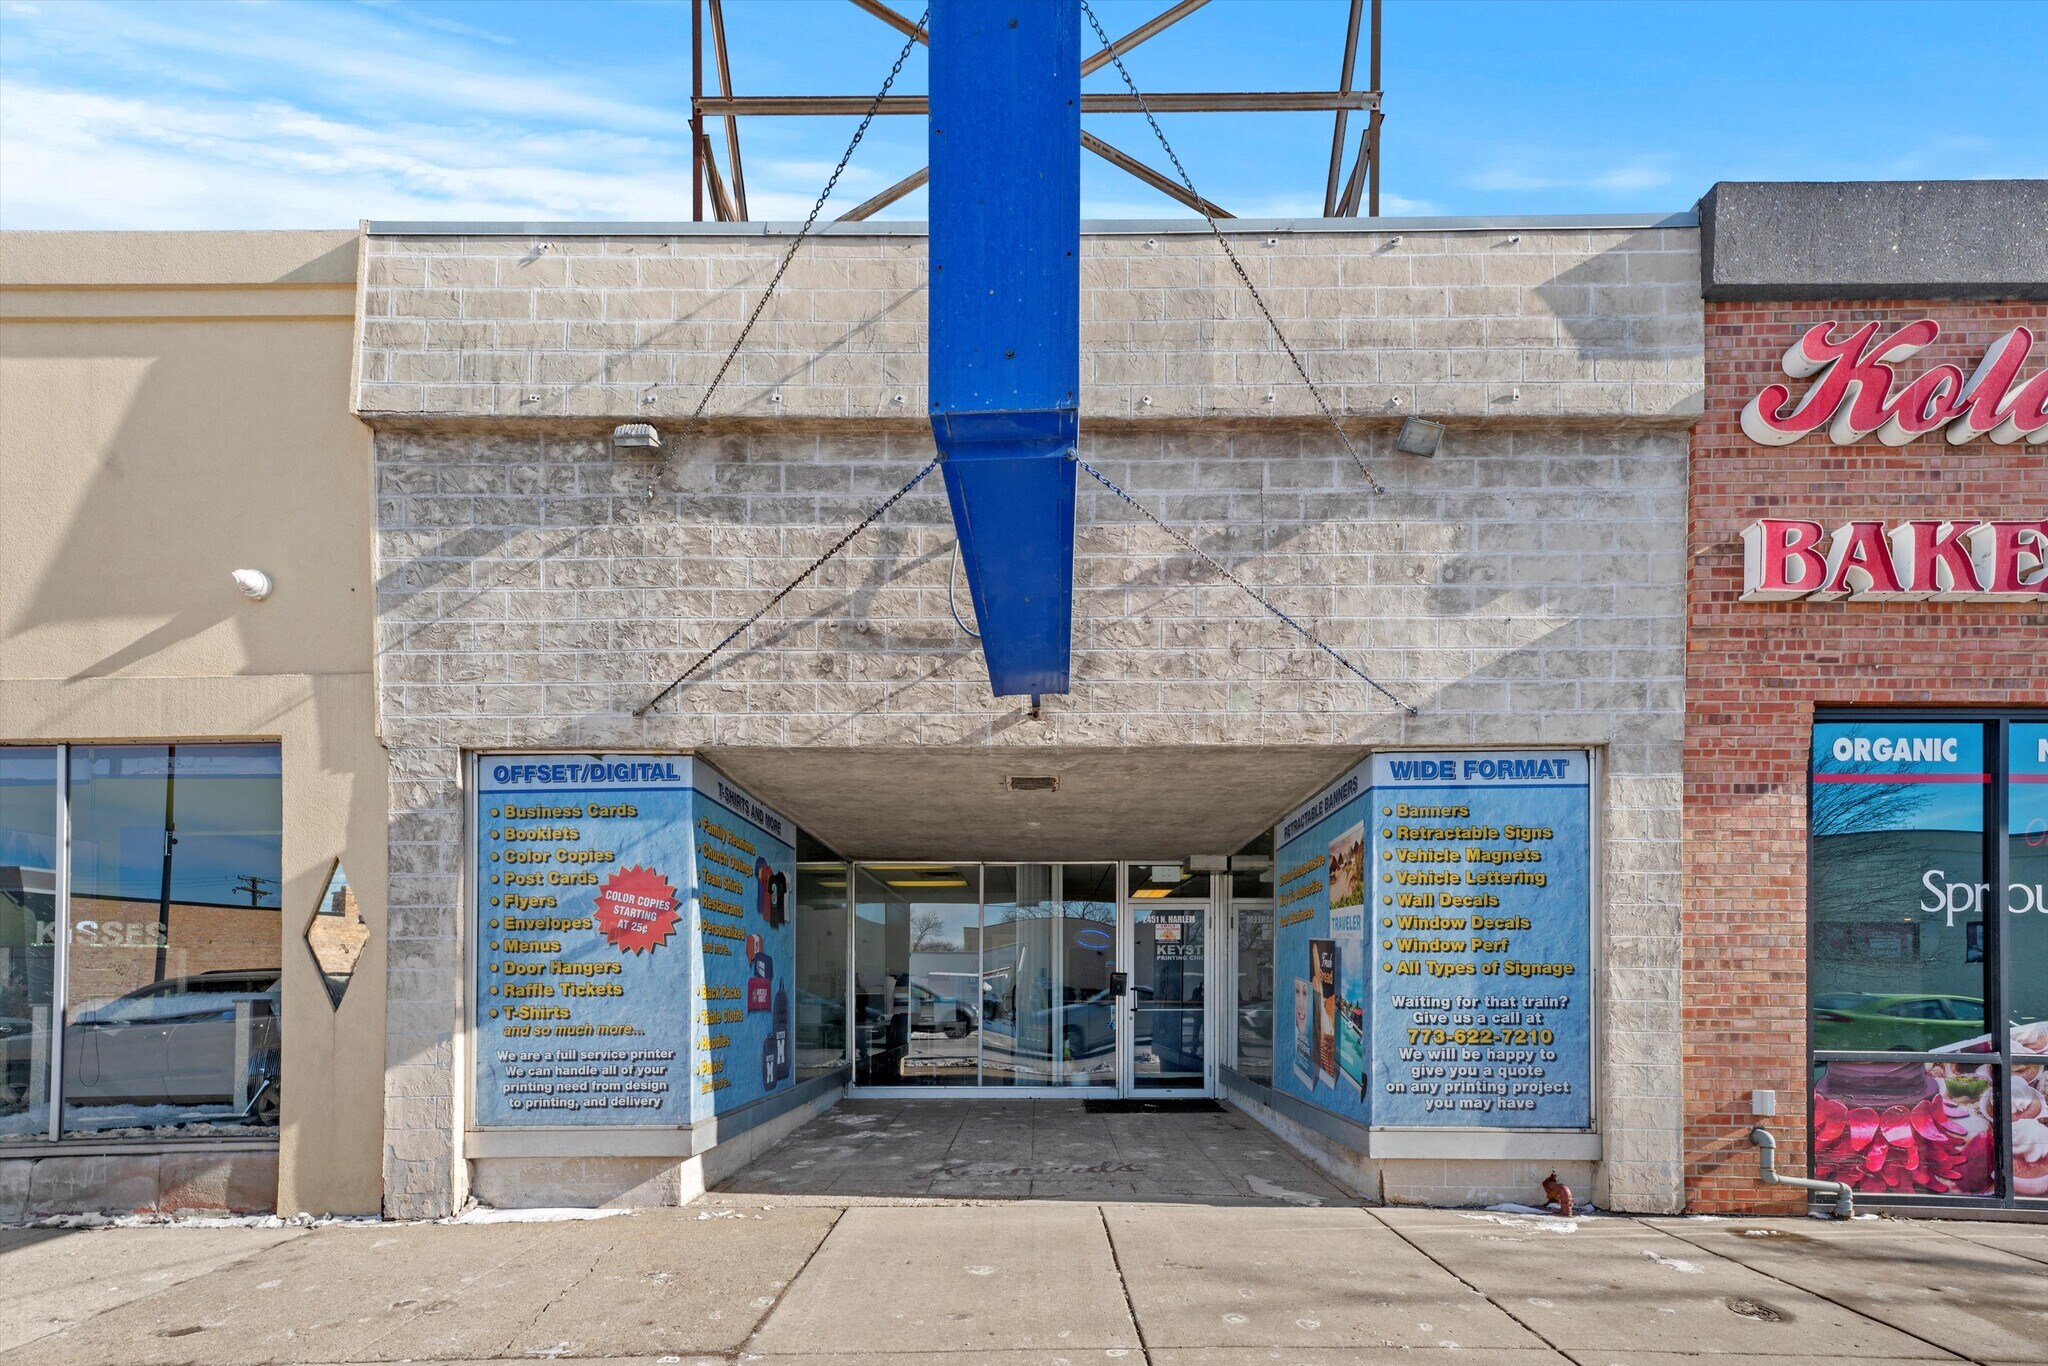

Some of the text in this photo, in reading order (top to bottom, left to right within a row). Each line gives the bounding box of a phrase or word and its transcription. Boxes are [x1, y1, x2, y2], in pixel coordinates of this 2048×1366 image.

[1832, 737, 1957, 762] ORGANIC
[493, 763, 679, 783] OFFSET/DIGITAL
[1390, 759, 1569, 780] WIDE FORMAT
[504, 803, 637, 819] Business Cards
[718, 782, 781, 836] T-SHIRTS AND MORE
[1284, 775, 1359, 840] RETRACTABLE BANNERS
[1396, 803, 1470, 818] Banners
[504, 826, 579, 841] Booklets
[702, 816, 756, 856] Family Reunions
[1396, 825, 1553, 841] Retractable Signs
[504, 848, 615, 865] Color Copies
[702, 842, 753, 878] Church Outings
[1396, 847, 1541, 864] Vehicle Magnets
[504, 870, 598, 886] Post Cards
[702, 867, 742, 895] Team Shirts
[1396, 870, 1547, 887] Vehicle Lettering
[504, 894, 557, 910] Flyers
[605, 890, 671, 911] COLOR COPIES
[702, 892, 743, 918] Restaurants
[1396, 892, 1499, 907] Wall Decals
[613, 905, 658, 922] STARTING
[1143, 915, 1196, 924] 2451 N. HARLEM
[504, 916, 593, 932] Envelopes
[617, 918, 648, 934] AT 25¢
[702, 918, 746, 941] Personalized
[1331, 914, 1361, 931] TRAVELER
[1396, 914, 1531, 930] Window Decals
[36, 920, 167, 945] KSSES
[503, 938, 561, 953] Menus
[1396, 937, 1509, 952] Window Perf
[503, 960, 621, 977] Door Hangers
[1396, 960, 1575, 978] All Types of Signage
[503, 982, 624, 998] Raffle Tickets
[702, 984, 719, 1000] Back
[722, 984, 742, 999] Packs
[1391, 995, 1570, 1011] Waiting for that train?
[502, 1005, 570, 1020] T-Shirts
[702, 1008, 744, 1025] Table Cloths
[1412, 1012, 1543, 1025] Give us a call at
[503, 1024, 530, 1037] and
[533, 1025, 550, 1036] so
[554, 1024, 593, 1036] much
[1407, 1028, 1554, 1045] 773-622-7210
[702, 1033, 731, 1050] Hoodies
[497, 1049, 675, 1061] We are a full service printer
[1399, 1047, 1557, 1063] We will be happy to
[505, 1065, 667, 1078] We can handle all of your
[702, 1058, 723, 1077] Polo's
[1411, 1064, 1545, 1080] give you a quote
[502, 1080, 669, 1093] printing need from design
[1386, 1080, 1571, 1096] on any printing project
[509, 1096, 662, 1110] to printing, and delivery
[1425, 1097, 1537, 1112] you may have
